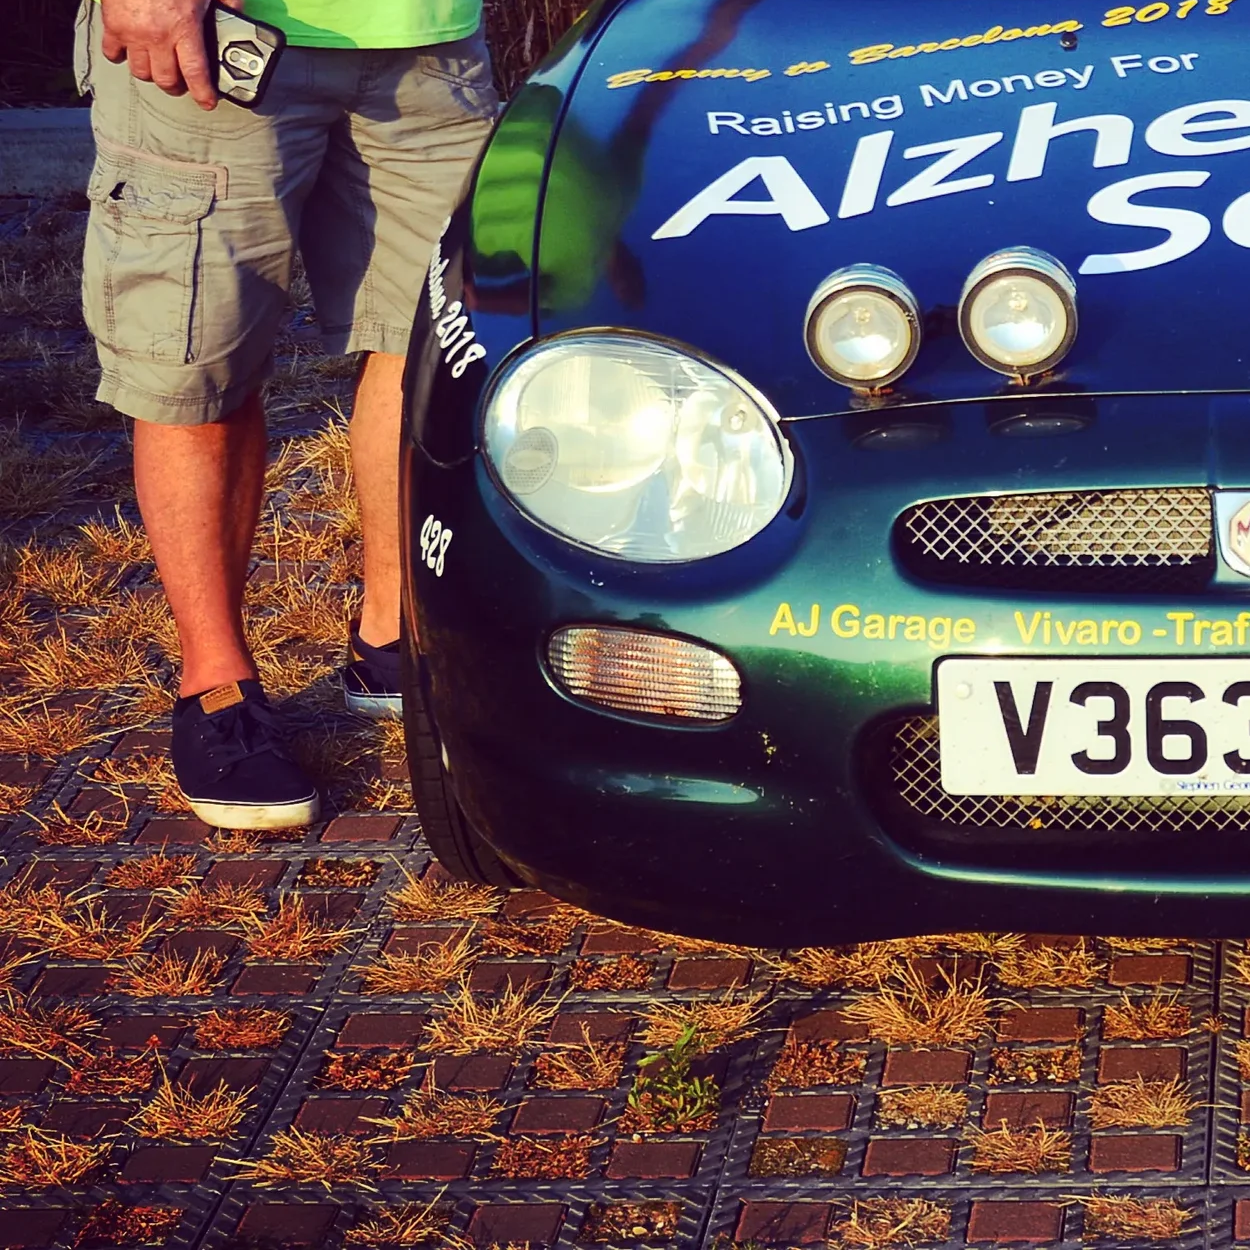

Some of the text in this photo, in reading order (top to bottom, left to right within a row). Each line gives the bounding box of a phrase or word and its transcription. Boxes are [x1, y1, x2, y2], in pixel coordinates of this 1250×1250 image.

[606, 66, 774, 89] Barmy
[783, 59, 830, 77] to
[848, 18, 1083, 67] Barcelona
[707, 50, 1199, 136] Raising Money For
[436, 301, 487, 378] 2018
[420, 514, 453, 577] 428
[769, 603, 821, 638] AJ
[831, 605, 976, 648] Garage
[1013, 611, 1142, 646] Vivaro
[1176, 780, 1219, 792] Stephen
